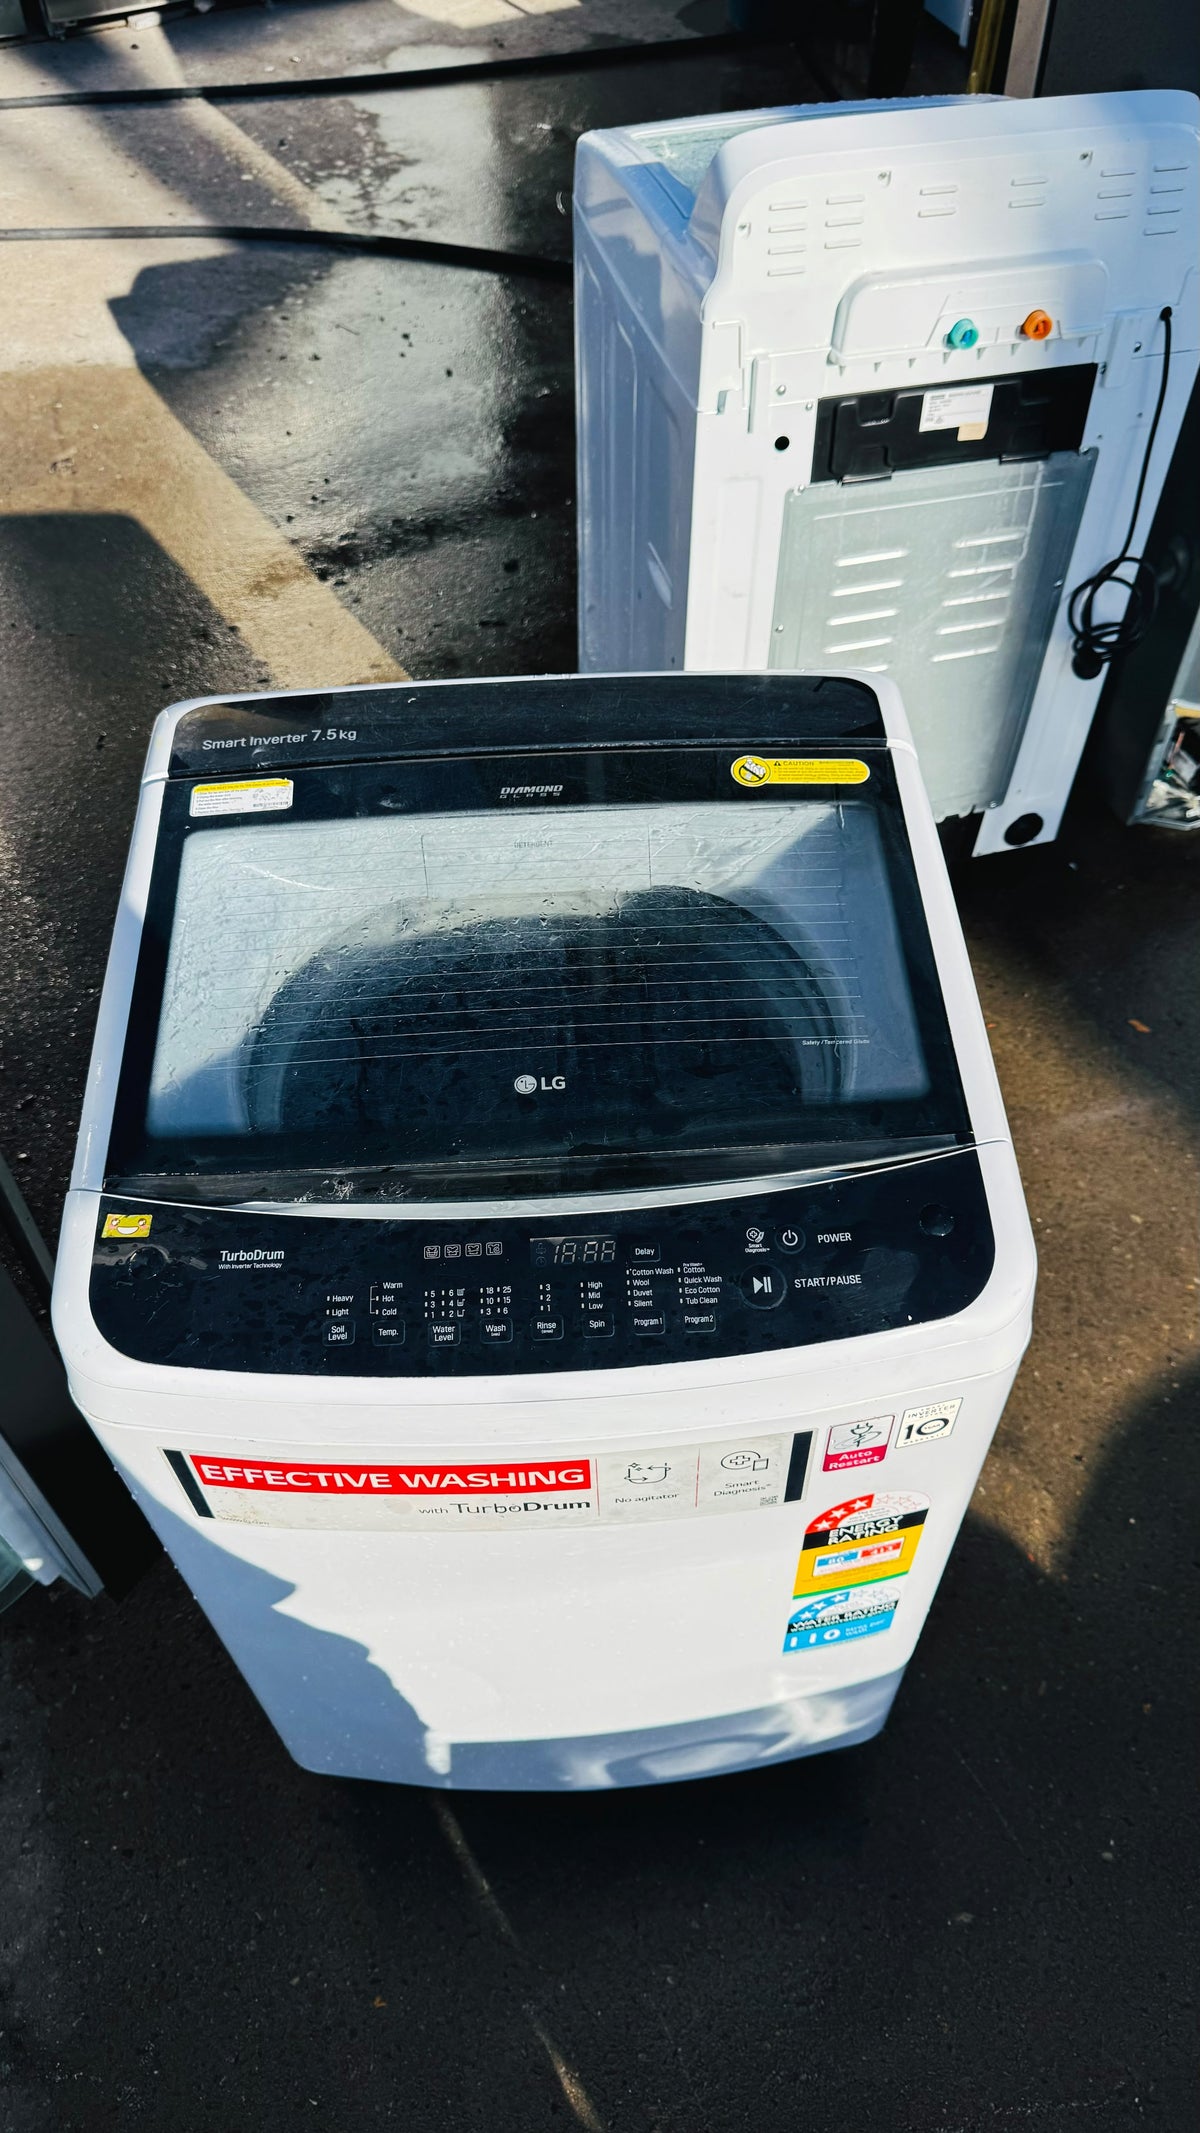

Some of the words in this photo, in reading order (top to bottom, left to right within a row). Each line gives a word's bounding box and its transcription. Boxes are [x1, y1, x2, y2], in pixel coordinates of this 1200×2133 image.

[202, 737, 247, 750] Smart
[250, 733, 307, 746] Inverter
[500, 785, 563, 794] DIAMOND
[540, 1076, 566, 1090] LG
[817, 1232, 852, 1243] POWER
[220, 1249, 285, 1262] TurboDrum
[635, 1248, 655, 1256] Delay
[632, 1268, 654, 1276] Cotton
[655, 1267, 674, 1275] Wash
[683, 1266, 706, 1274] Cotton
[684, 1276, 702, 1284] Quick
[703, 1275, 723, 1283] Wash
[794, 1274, 862, 1288] START/PAUSE
[382, 1281, 403, 1289] Warm
[502, 1285, 512, 1294] 25
[545, 1283, 551, 1291] 3
[587, 1281, 603, 1290] High
[430, 1290, 436, 1298] 5
[448, 1289, 454, 1297] 6
[588, 1291, 601, 1299] Mid
[633, 1289, 653, 1297] Duvet
[332, 1295, 354, 1303] Heavy
[486, 1297, 494, 1305] 10
[503, 1296, 511, 1304] 15
[685, 1297, 699, 1305] Tub
[699, 1296, 718, 1304] Clean
[430, 1300, 436, 1308] 3
[588, 1302, 604, 1310] Low
[331, 1308, 349, 1317] Light
[381, 1308, 397, 1316] Cold
[448, 1310, 454, 1318] 2
[634, 1317, 659, 1327] Program
[684, 1315, 709, 1324] Program
[331, 1325, 345, 1333] Soil
[432, 1325, 456, 1333] Water
[485, 1324, 506, 1332] Wash
[536, 1321, 557, 1329] Rinse
[589, 1320, 605, 1329] Spin
[328, 1331, 348, 1341] Level
[378, 1328, 399, 1337] Temp.
[434, 1333, 454, 1342] Level
[908, 1404, 955, 1418] INVERTER
[905, 1417, 950, 1440] 10
[838, 1450, 873, 1461] Auto
[828, 1455, 880, 1470] Restart
[200, 1463, 393, 1488] EFFECTIVE
[399, 1468, 585, 1488] WASHING
[725, 1479, 760, 1488] Smart
[634, 1492, 680, 1504] agitator
[449, 1501, 591, 1514] TurboDrum
[829, 1515, 904, 1538] ENERGY
[827, 1523, 899, 1546] RATING
[792, 1613, 840, 1629] WATER
[844, 1601, 896, 1618] RATING
